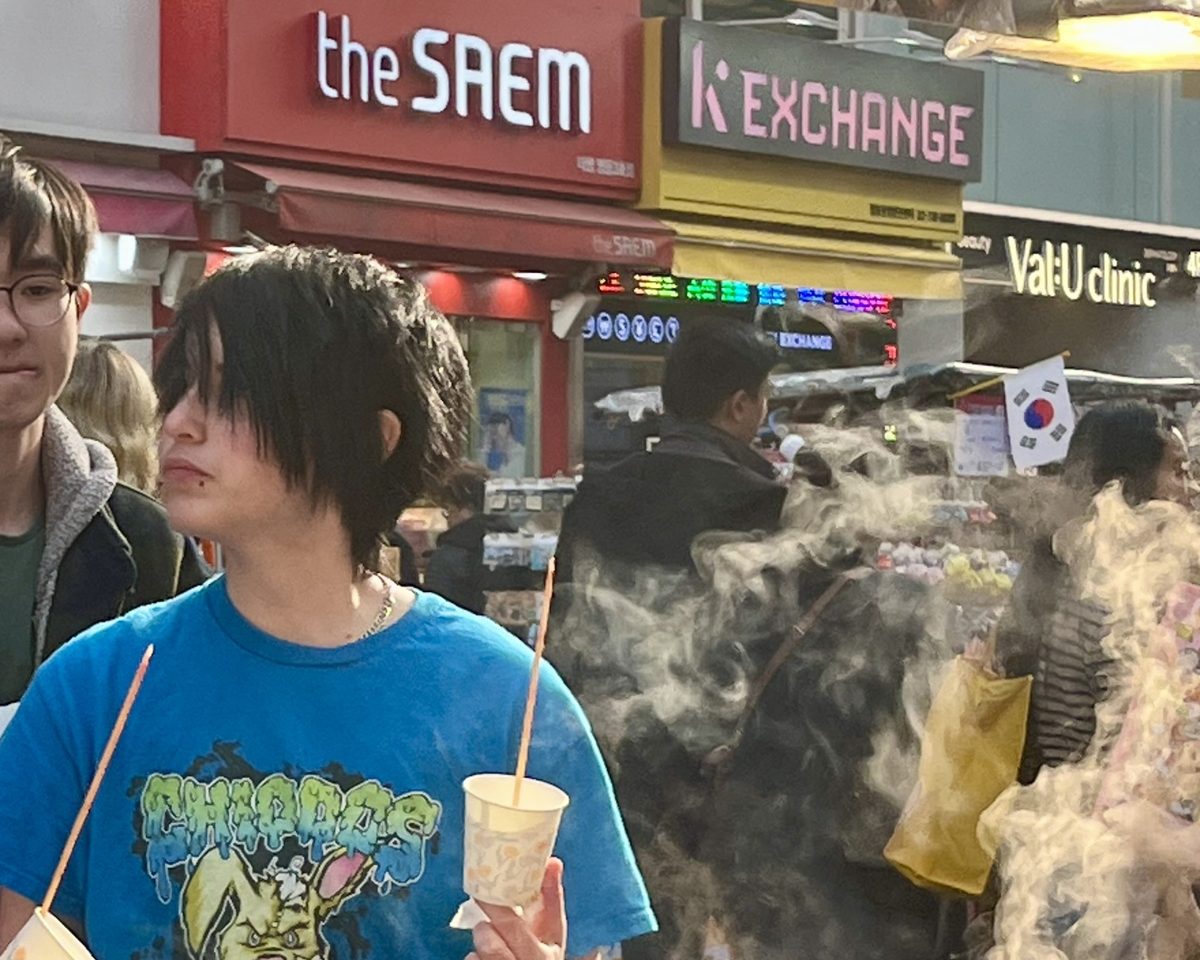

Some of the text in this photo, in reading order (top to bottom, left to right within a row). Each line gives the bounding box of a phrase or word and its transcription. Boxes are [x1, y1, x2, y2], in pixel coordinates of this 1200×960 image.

[318, 10, 590, 134] the SAEM
[740, 69, 975, 167] EXCHANGE
[1087, 252, 1157, 308] clinic
